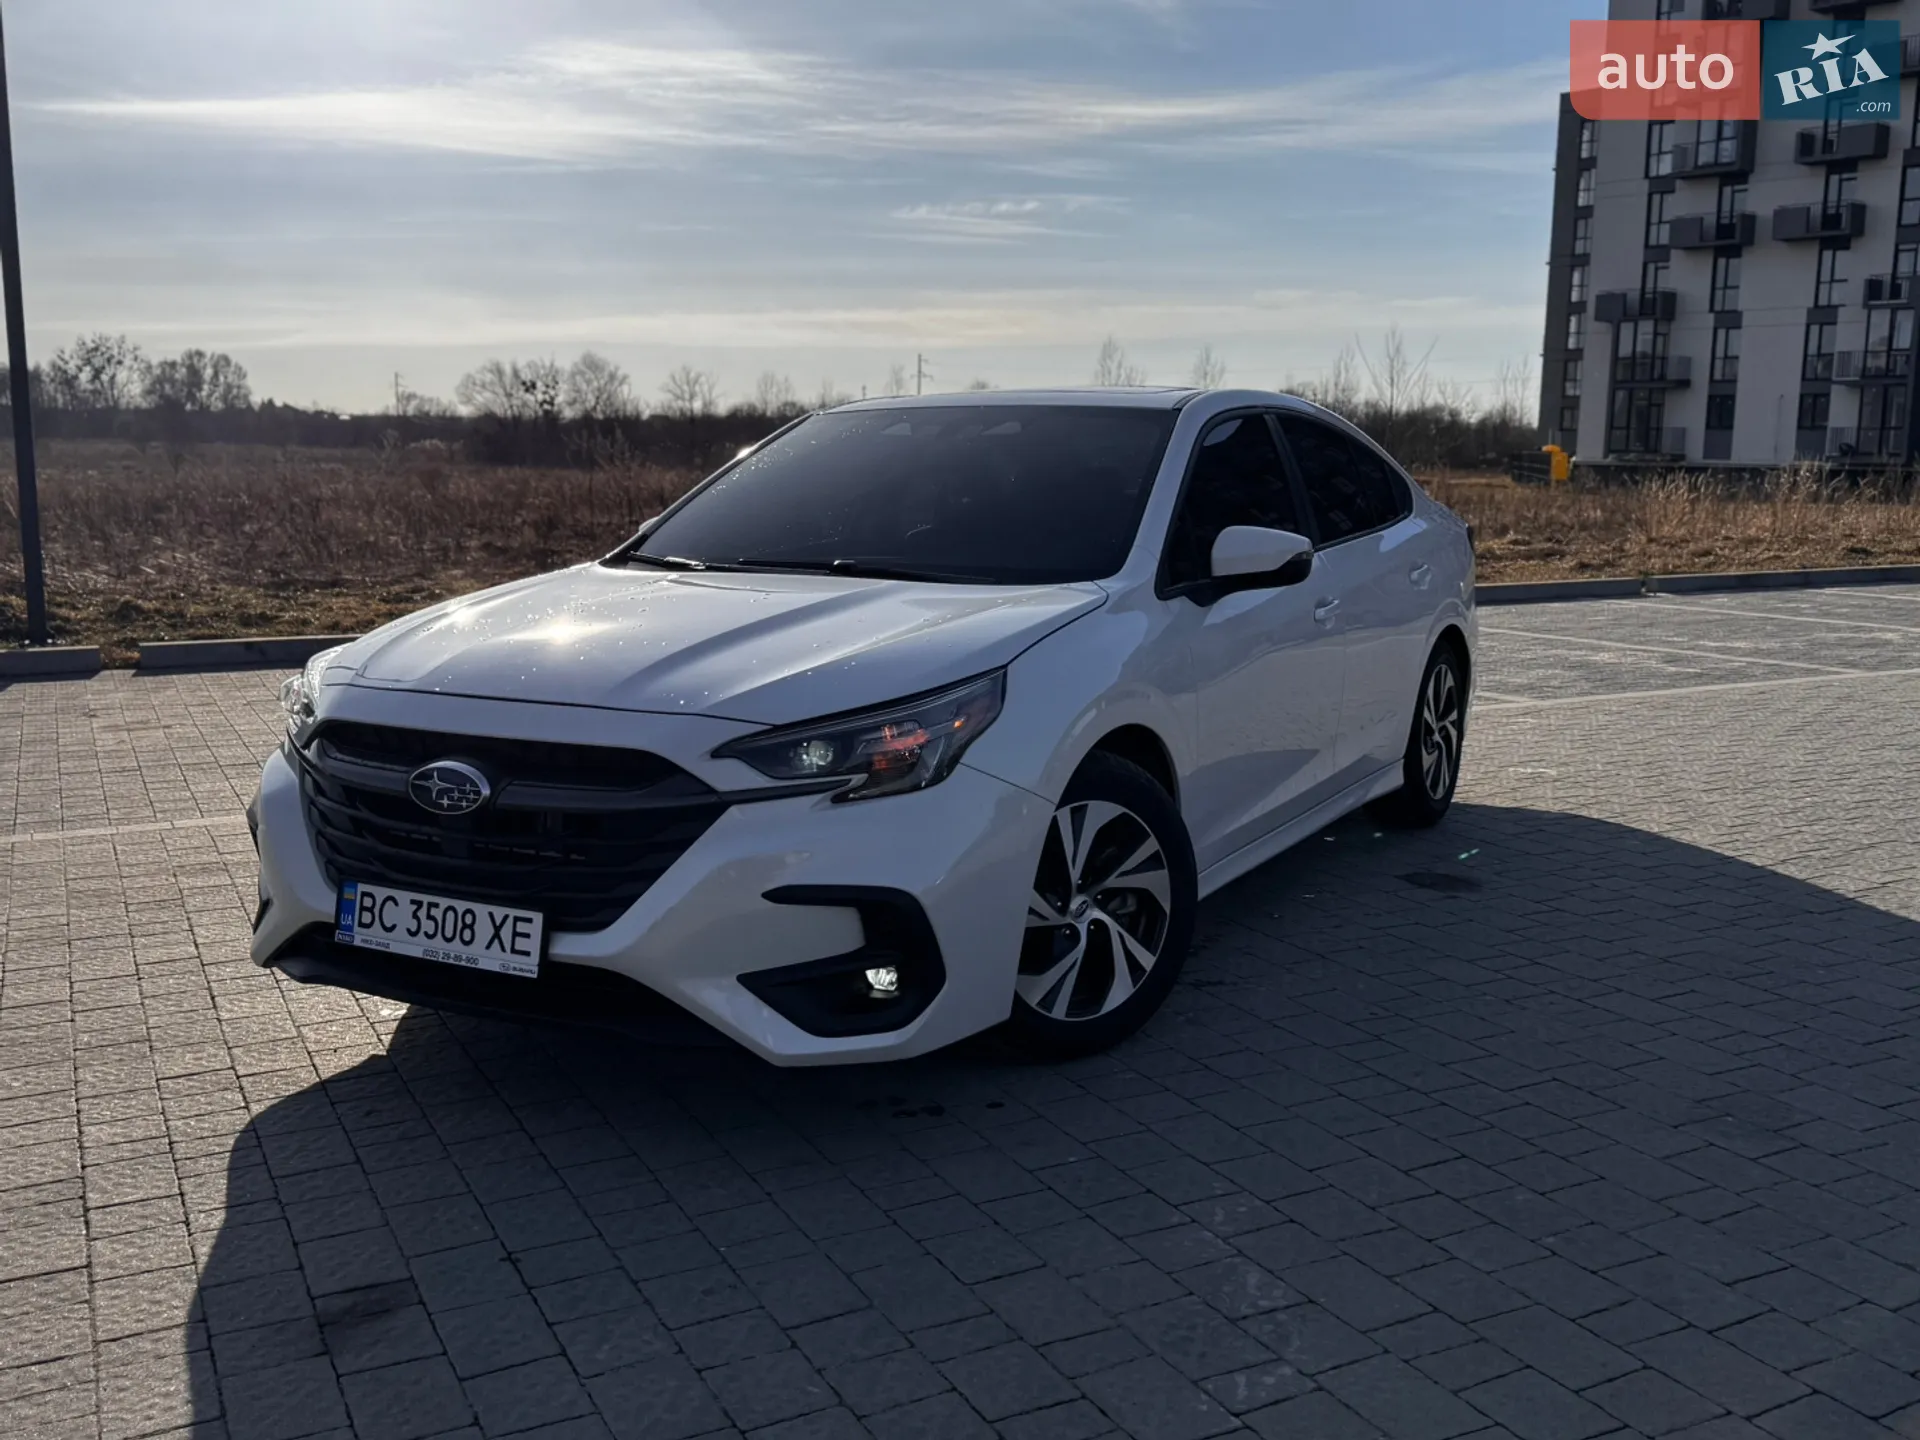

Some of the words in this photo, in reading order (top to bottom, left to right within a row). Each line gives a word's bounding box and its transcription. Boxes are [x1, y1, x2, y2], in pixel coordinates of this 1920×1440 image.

[340, 913, 353, 926] UA
[357, 891, 399, 933] BC
[406, 899, 477, 947] 3508
[485, 911, 534, 957] XE
[422, 949, 440, 961] (032)
